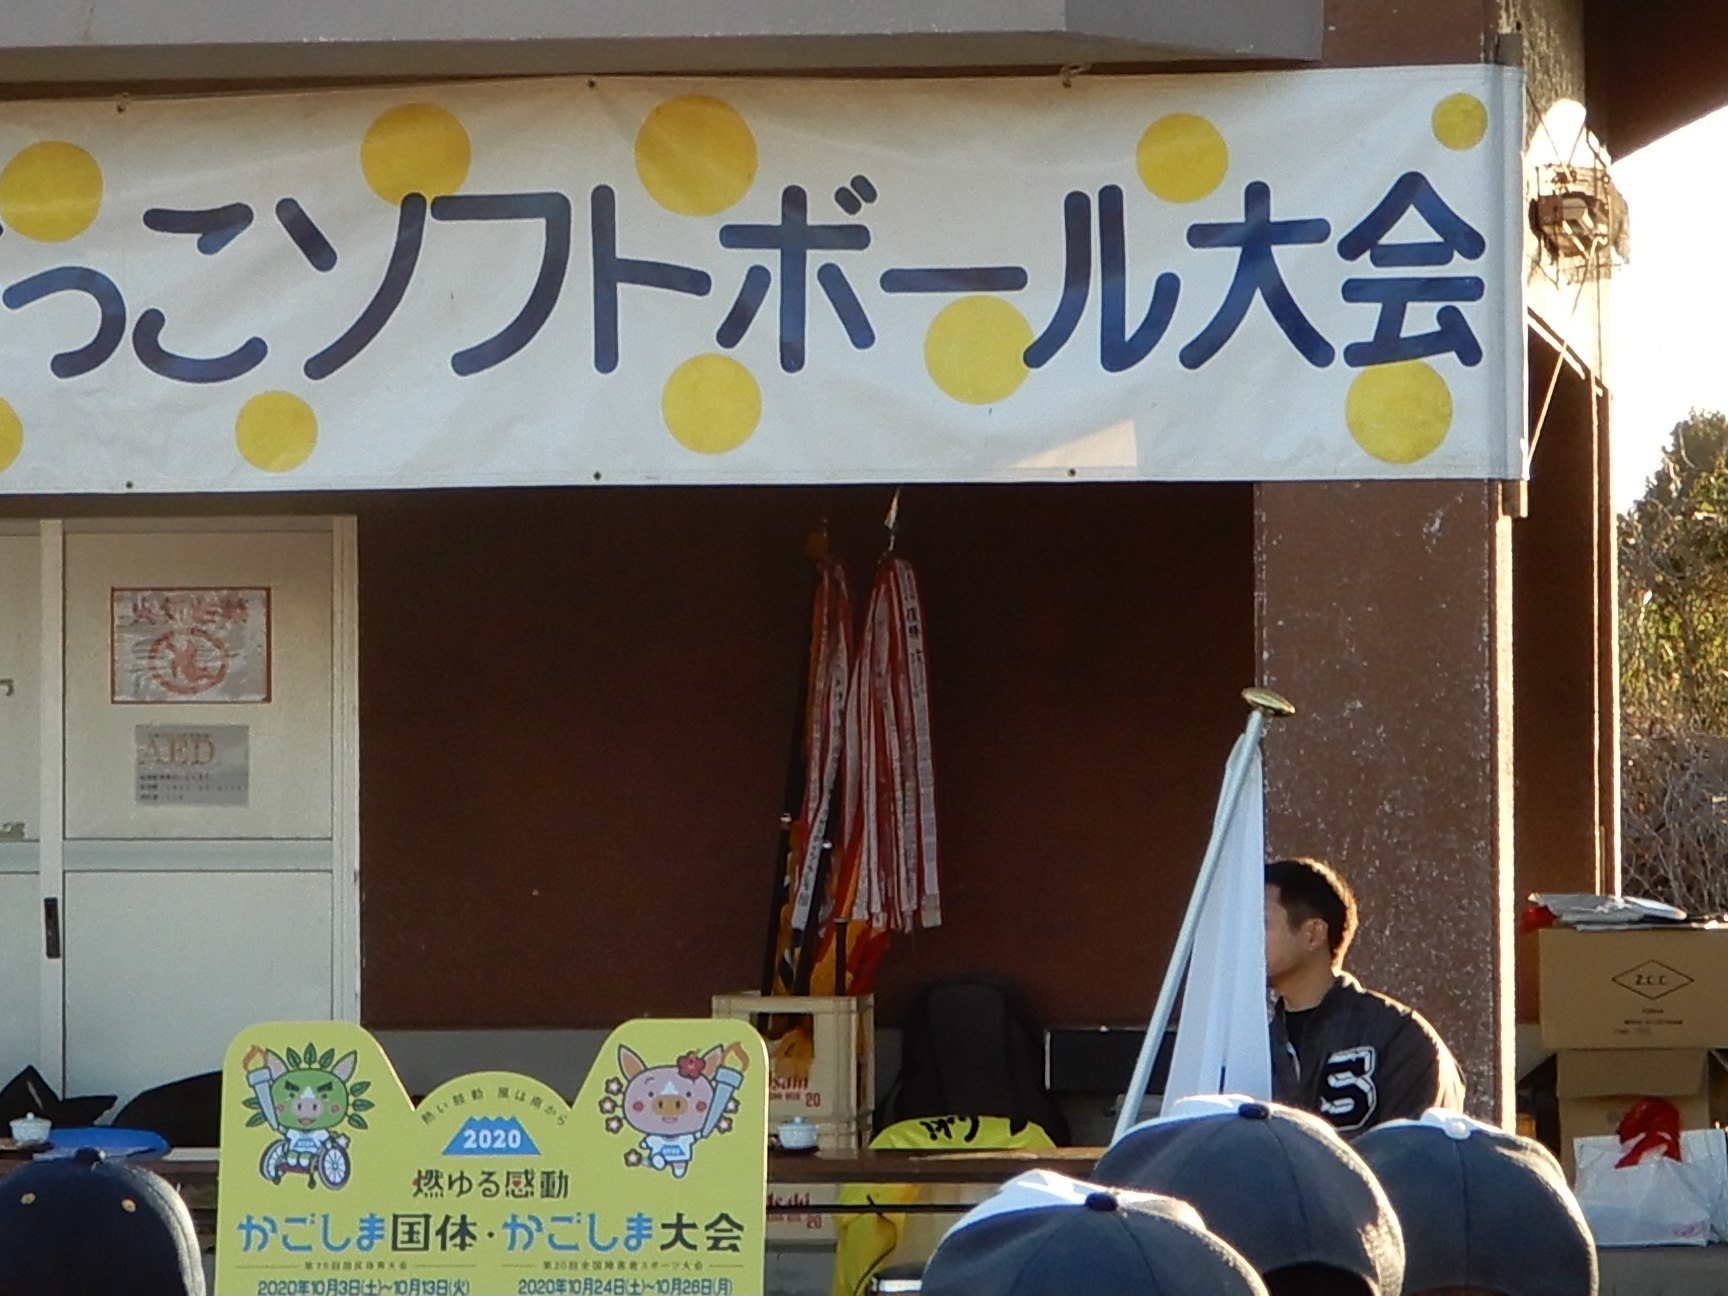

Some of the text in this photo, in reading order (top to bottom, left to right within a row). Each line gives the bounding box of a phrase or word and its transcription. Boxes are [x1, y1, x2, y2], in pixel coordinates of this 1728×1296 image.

[462, 1128, 522, 1150] 2020
[412, 1167, 570, 1200] 燃ゆる感動
